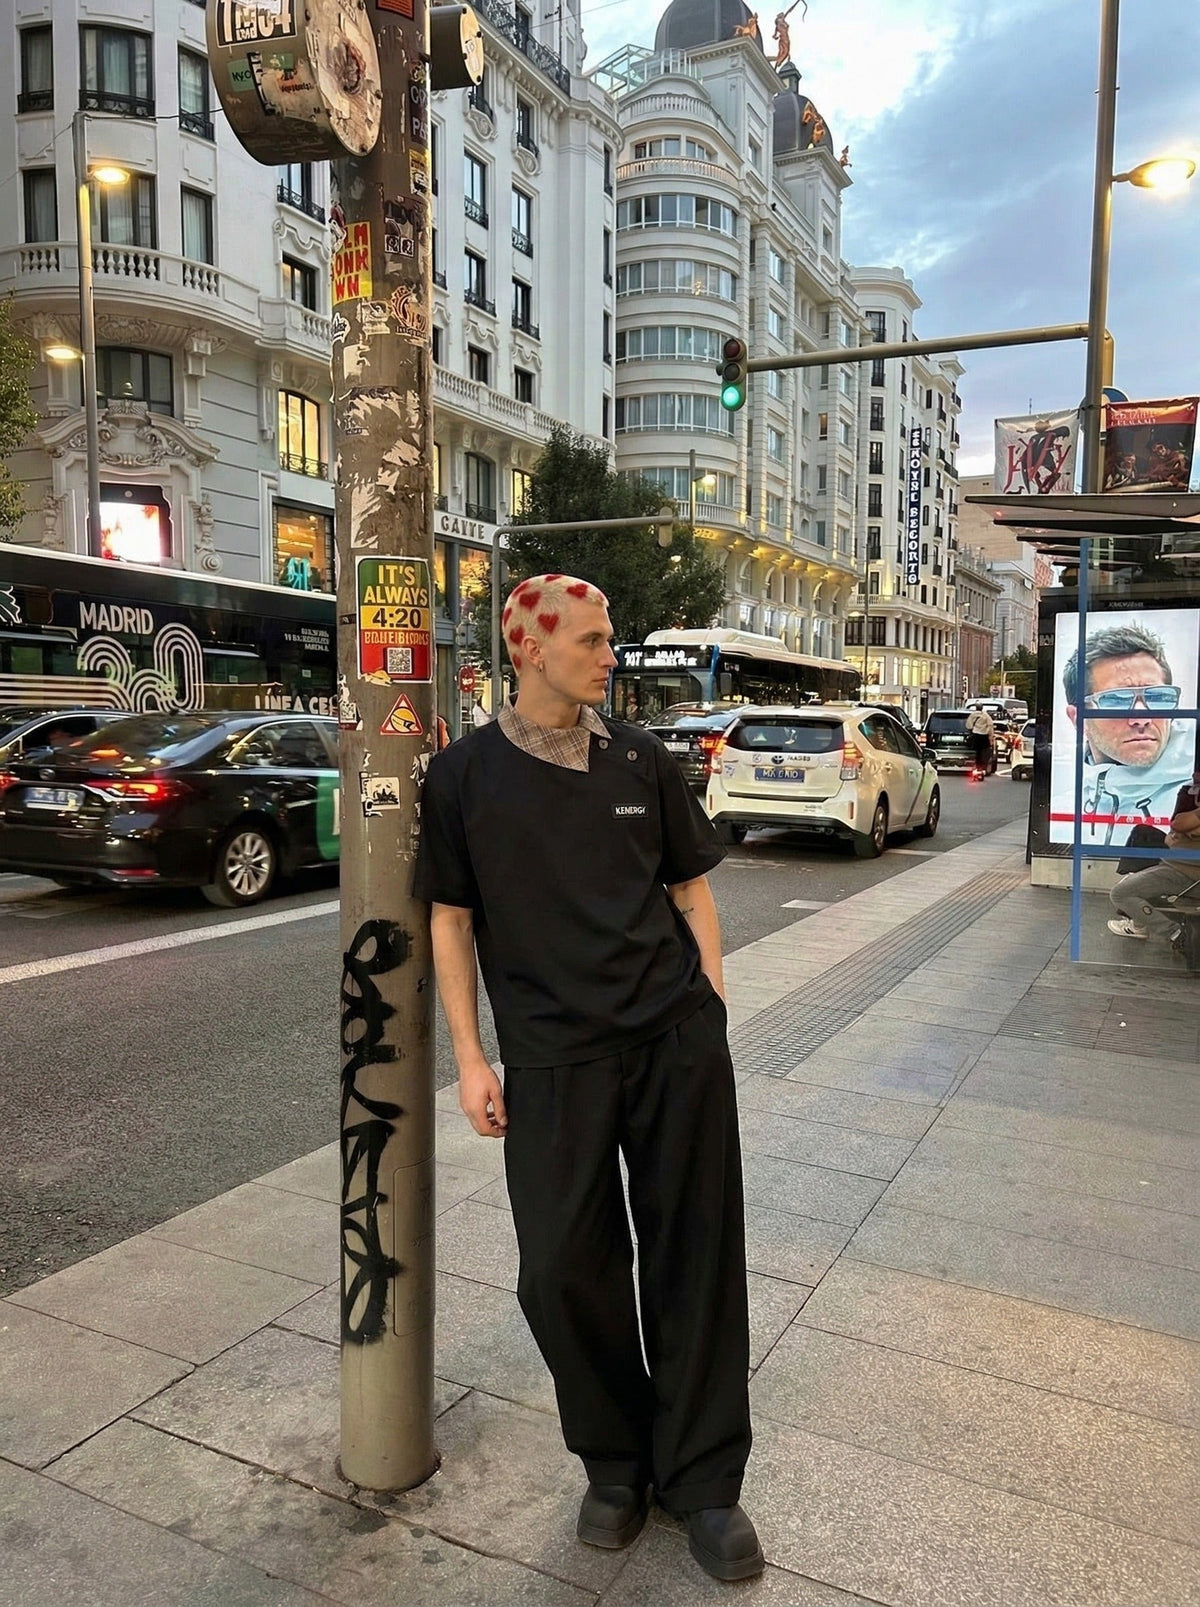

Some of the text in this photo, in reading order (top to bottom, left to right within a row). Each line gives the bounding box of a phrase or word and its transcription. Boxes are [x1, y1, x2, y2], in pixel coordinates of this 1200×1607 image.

[378, 565, 415, 586] IT'S
[364, 585, 428, 606] ALWAYS
[80, 601, 154, 635] MADRID
[372, 607, 422, 629] 4:20
